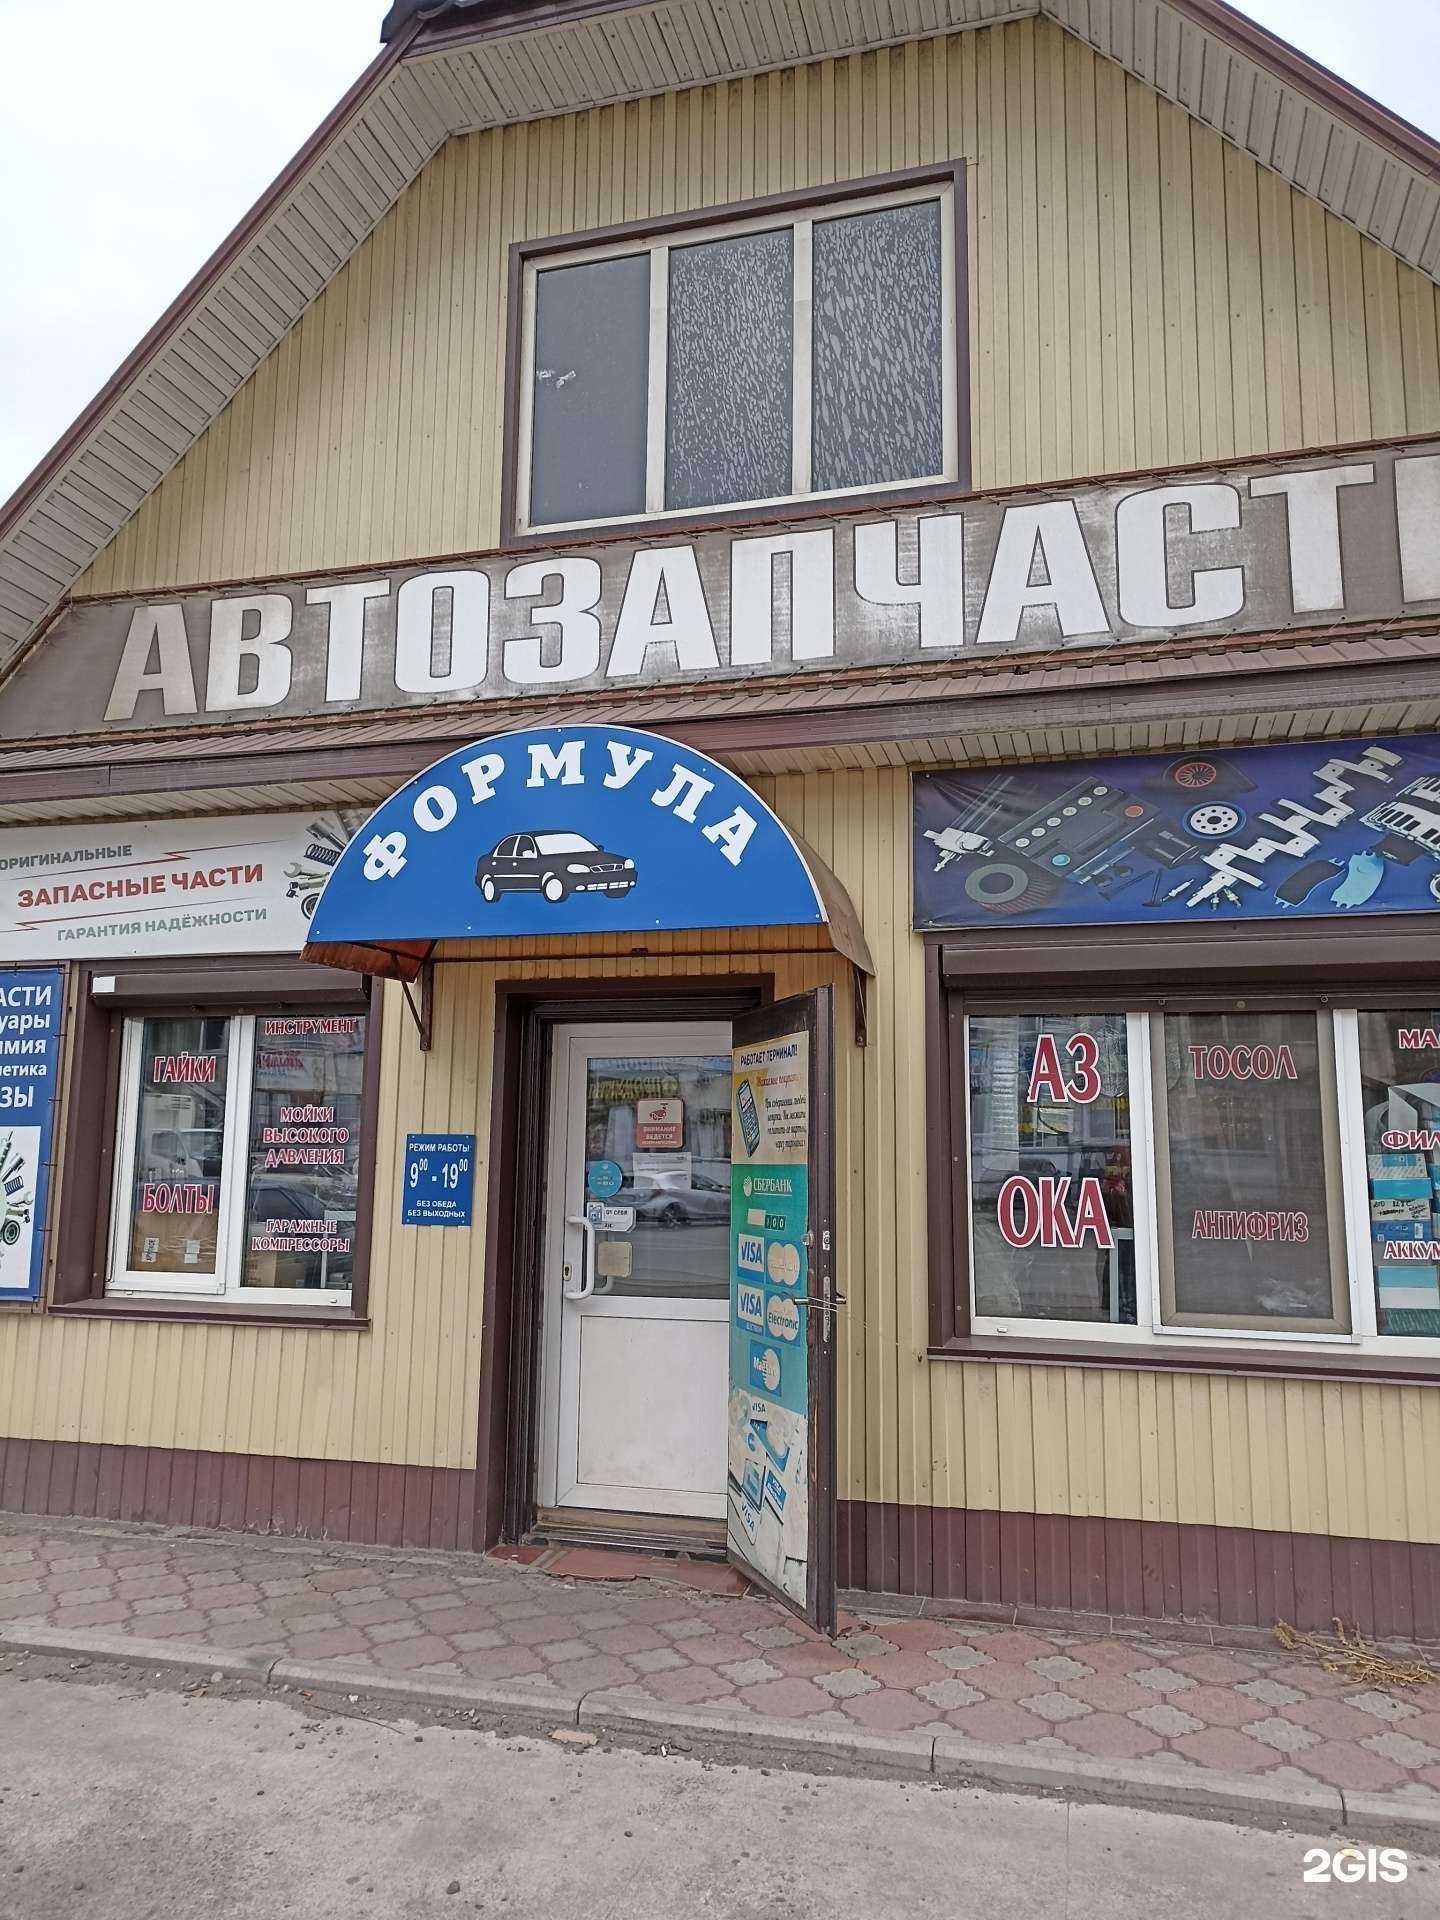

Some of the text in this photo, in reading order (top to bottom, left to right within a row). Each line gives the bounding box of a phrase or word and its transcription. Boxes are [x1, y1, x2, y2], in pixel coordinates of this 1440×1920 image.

[362, 739, 758, 882] ФОРМУЛА
[0, 845, 132, 871] ОРИГИНАЛЬНЫЕ
[17, 863, 263, 908] ЗАПАСНЫЕ ЧАСТИ
[57, 908, 267, 942] ГАРАНТИЯ НАДЁЖНОСТИ
[265, 1017, 356, 1035] ИНСТРУМЕНТ
[0, 1040, 47, 1055] мия
[1398, 1028, 1440, 1049] МА
[153, 1052, 216, 1083] ГАЙКИ
[740, 1051, 766, 1067] РАБОТАЕТ
[1188, 1044, 1298, 1080] ТОСОЛ
[0, 1064, 47, 1077] етика
[280, 1104, 334, 1123] МОЙКИ
[263, 1127, 349, 1144] ВЫСОКОГО
[409, 1143, 436, 1152] РЕЖИМ
[264, 1148, 345, 1169] ДАВЛЕНИЯ
[753, 1176, 793, 1193] СБЕРБАНК
[142, 1183, 214, 1214] БОЛТЫ
[416, 1200, 457, 1209] БЕЗ ОБЕДА
[407, 1209, 466, 1219] БЕЗ ВЫХОДНЫХ
[997, 1175, 1115, 1248] ОКА
[265, 1218, 338, 1234] ГАРАЖНЫЕ
[1191, 1210, 1309, 1242] АНТИФРИЗ
[251, 1236, 350, 1253] КОМПРЕССОРЫ
[741, 1241, 763, 1264] VISA
[740, 1292, 762, 1317] VISA
[768, 1312, 798, 1330] Electronic
[751, 1402, 766, 1412] VISA
[741, 1503, 755, 1532] VISA
